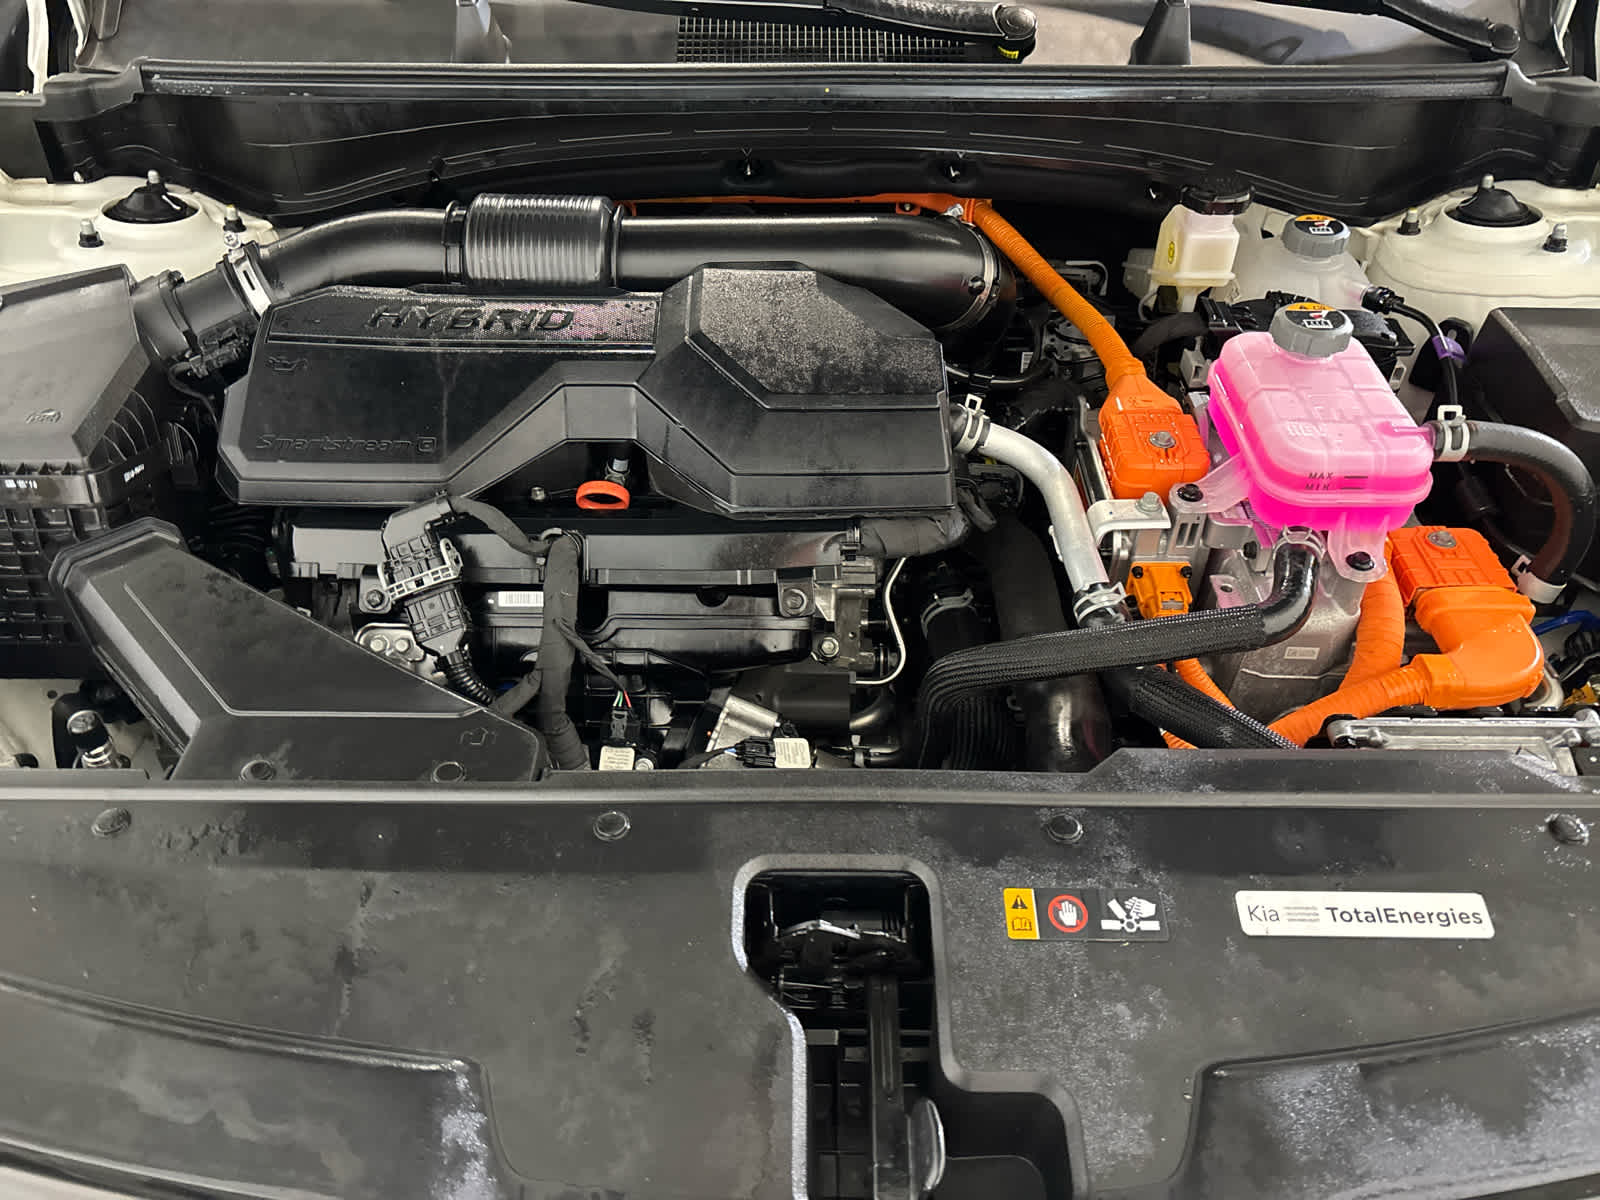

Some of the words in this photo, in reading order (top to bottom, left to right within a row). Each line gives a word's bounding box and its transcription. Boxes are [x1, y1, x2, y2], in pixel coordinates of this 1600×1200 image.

[366, 305, 575, 331] HYBRID
[256, 434, 412, 451] Smartstream
[1304, 483, 1330, 491] MIN
[1247, 905, 1280, 922] Kia
[1325, 906, 1483, 927] TotalEnergies
